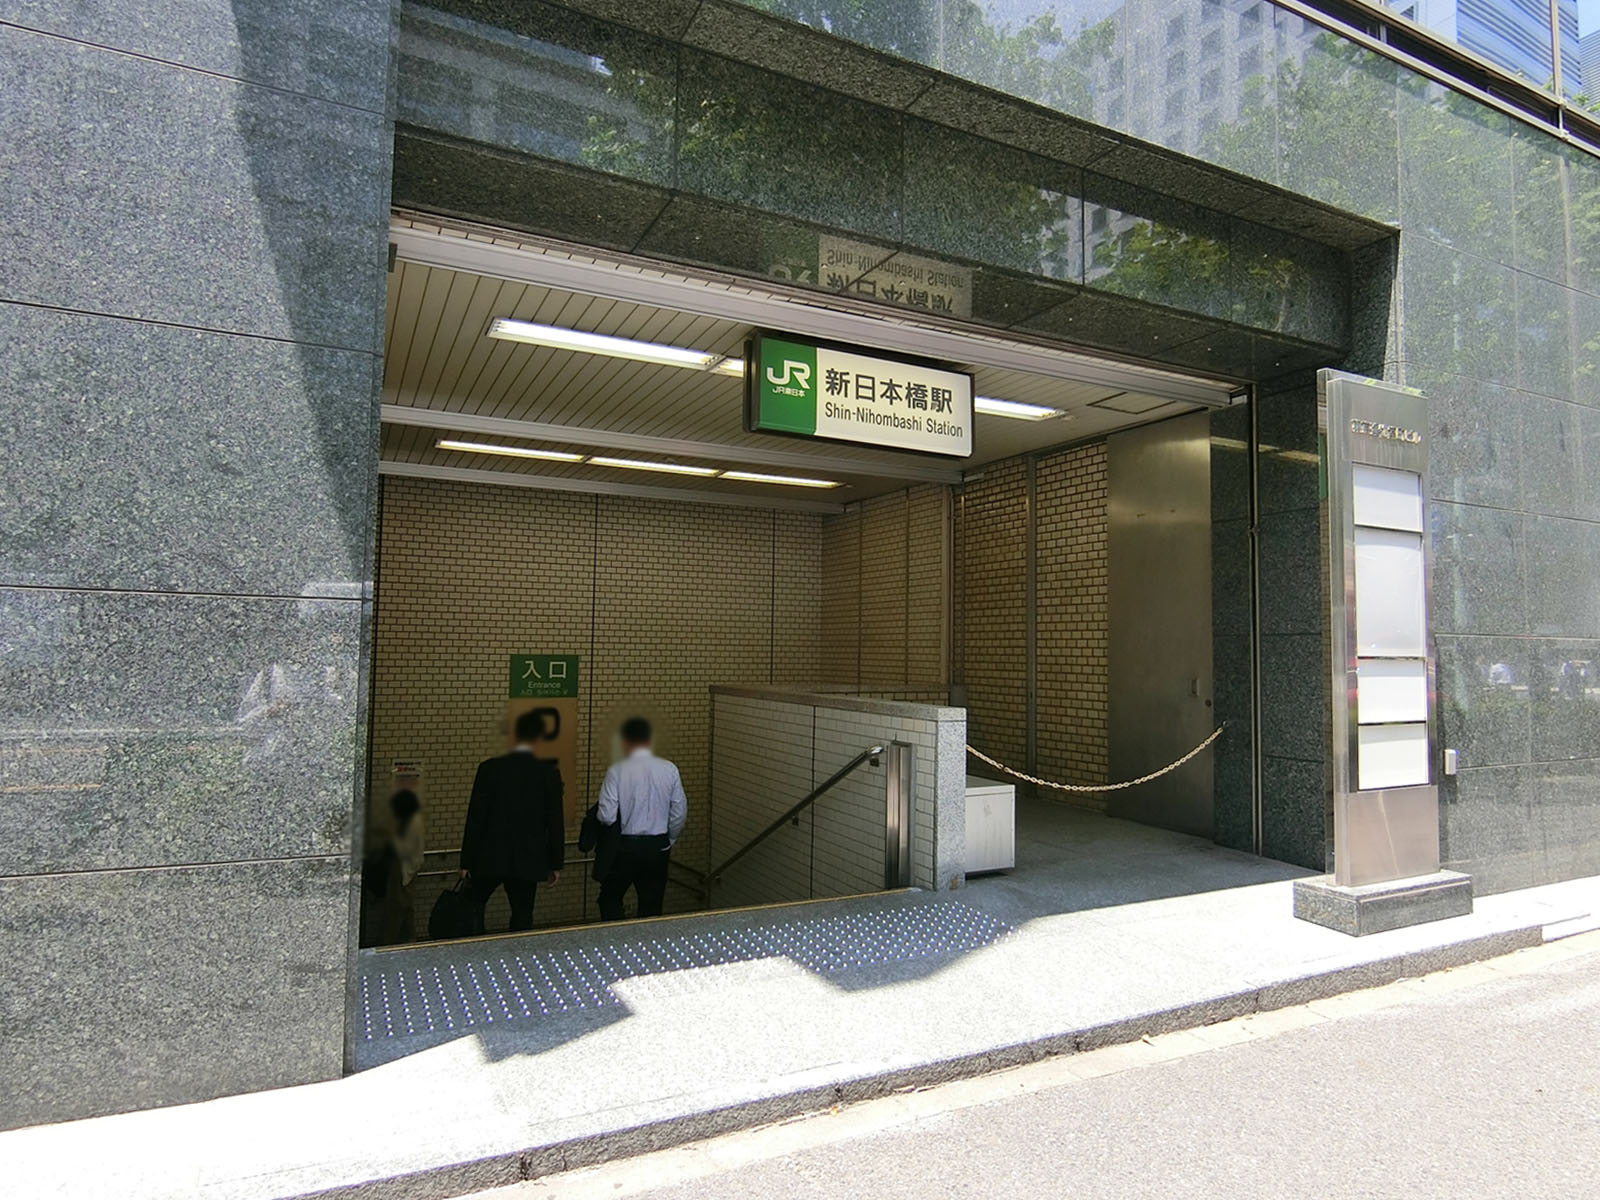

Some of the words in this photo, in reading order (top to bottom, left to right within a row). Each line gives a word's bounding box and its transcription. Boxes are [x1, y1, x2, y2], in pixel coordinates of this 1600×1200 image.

[766, 359, 811, 390] JR
[772, 386, 806, 398] JR東日本
[825, 368, 953, 415] 新日本橋駅
[825, 402, 923, 432] Shin-Nihombashi
[926, 418, 964, 438] Station
[522, 660, 567, 679] 入口
[527, 680, 561, 689] Entrance
